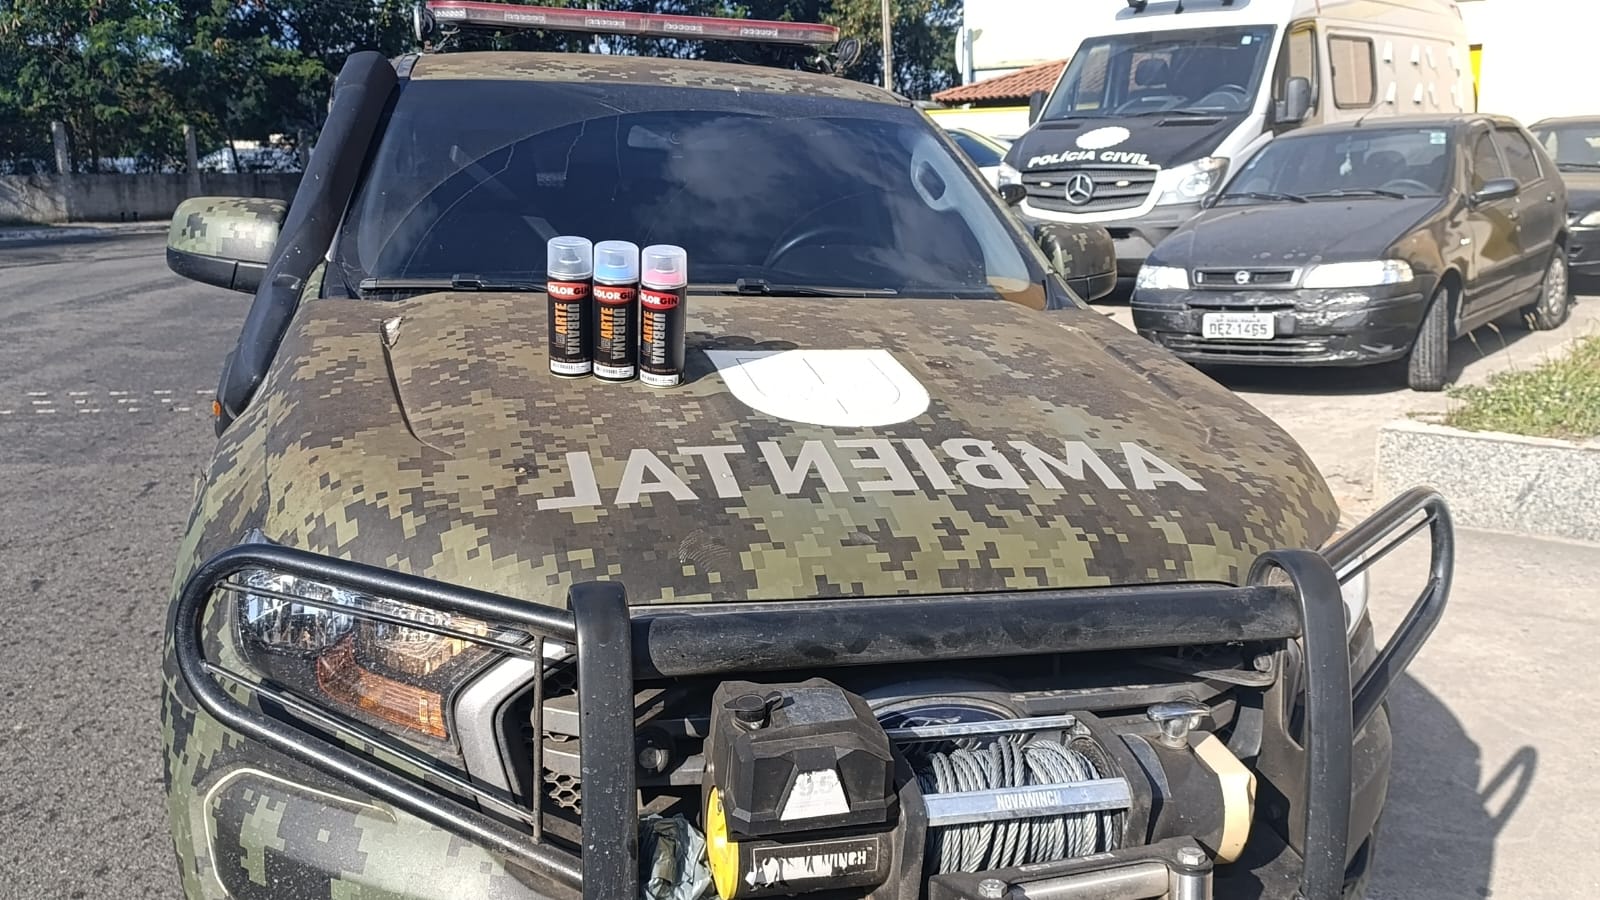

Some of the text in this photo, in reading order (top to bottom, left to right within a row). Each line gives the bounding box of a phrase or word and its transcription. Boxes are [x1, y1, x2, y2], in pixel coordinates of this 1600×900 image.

[1028, 150, 1151, 168] POLÍCIA CIVIL
[555, 302, 567, 334] ARTE
[567, 303, 580, 355] URBANA
[601, 307, 613, 339] ARTE
[612, 308, 626, 360] URBANA
[643, 310, 654, 343] ARTE
[651, 313, 666, 365] URBANA
